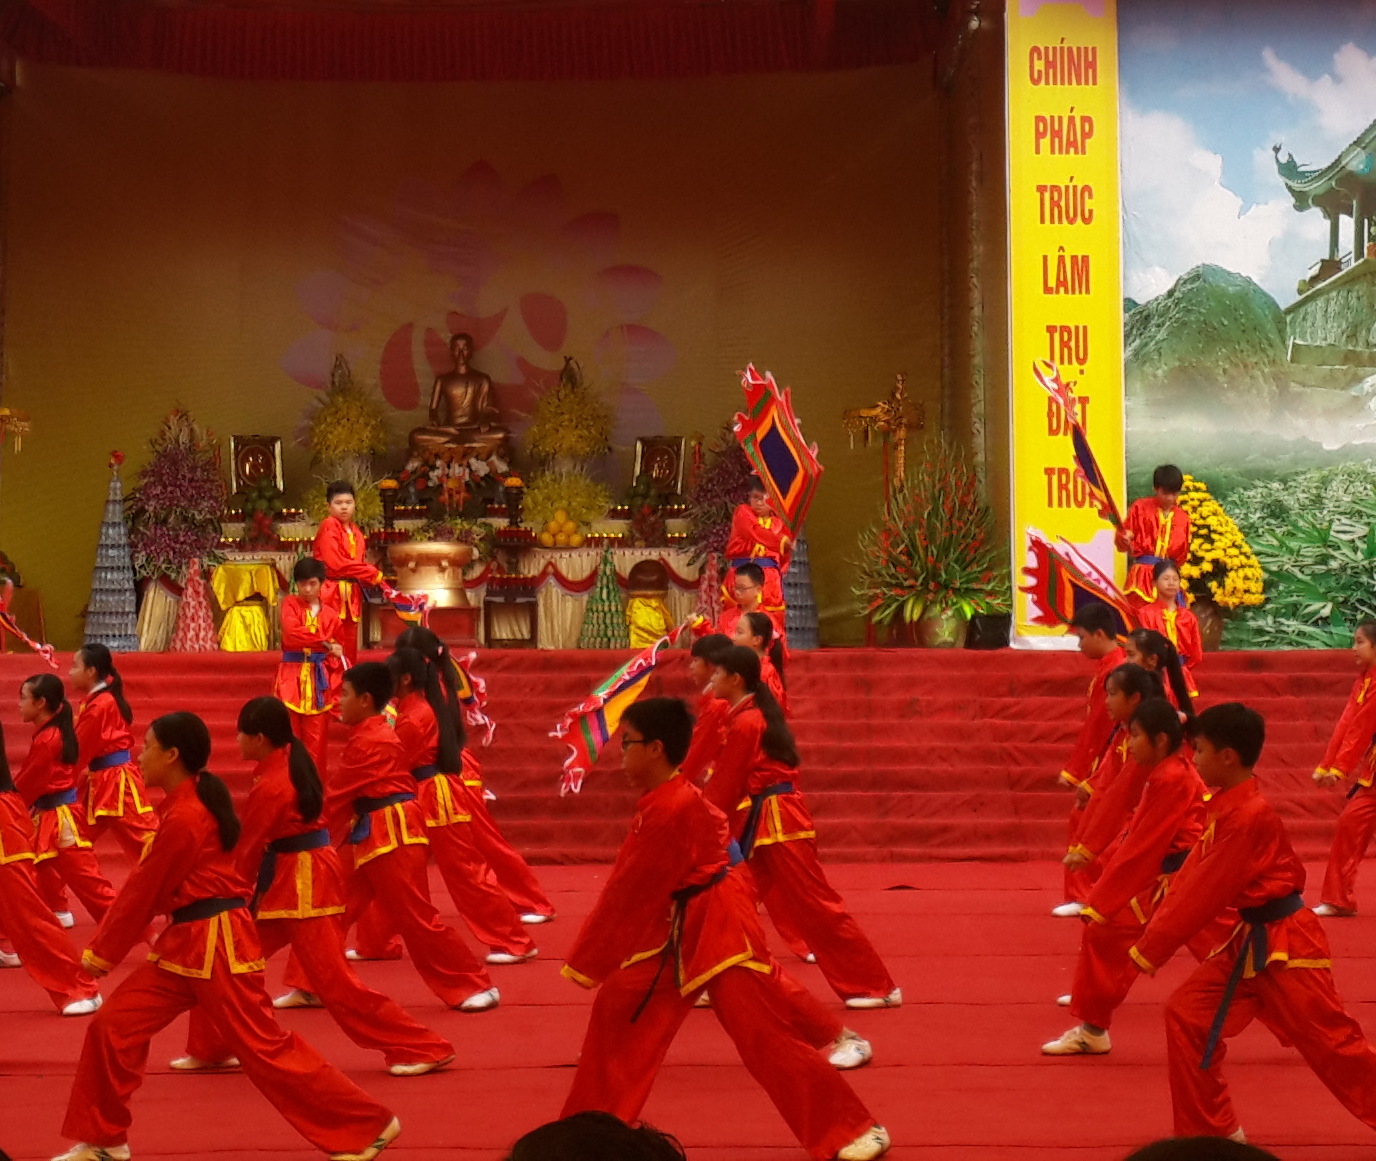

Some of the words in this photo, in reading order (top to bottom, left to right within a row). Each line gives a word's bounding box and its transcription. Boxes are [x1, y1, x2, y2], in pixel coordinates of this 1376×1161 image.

[1029, 37, 1097, 86] CHÍNH
[1035, 107, 1093, 155] PHÁP
[1037, 176, 1093, 225] TRÚC
[1043, 246, 1090, 294] LÂM
[1045, 325, 1089, 375] TRỤ
